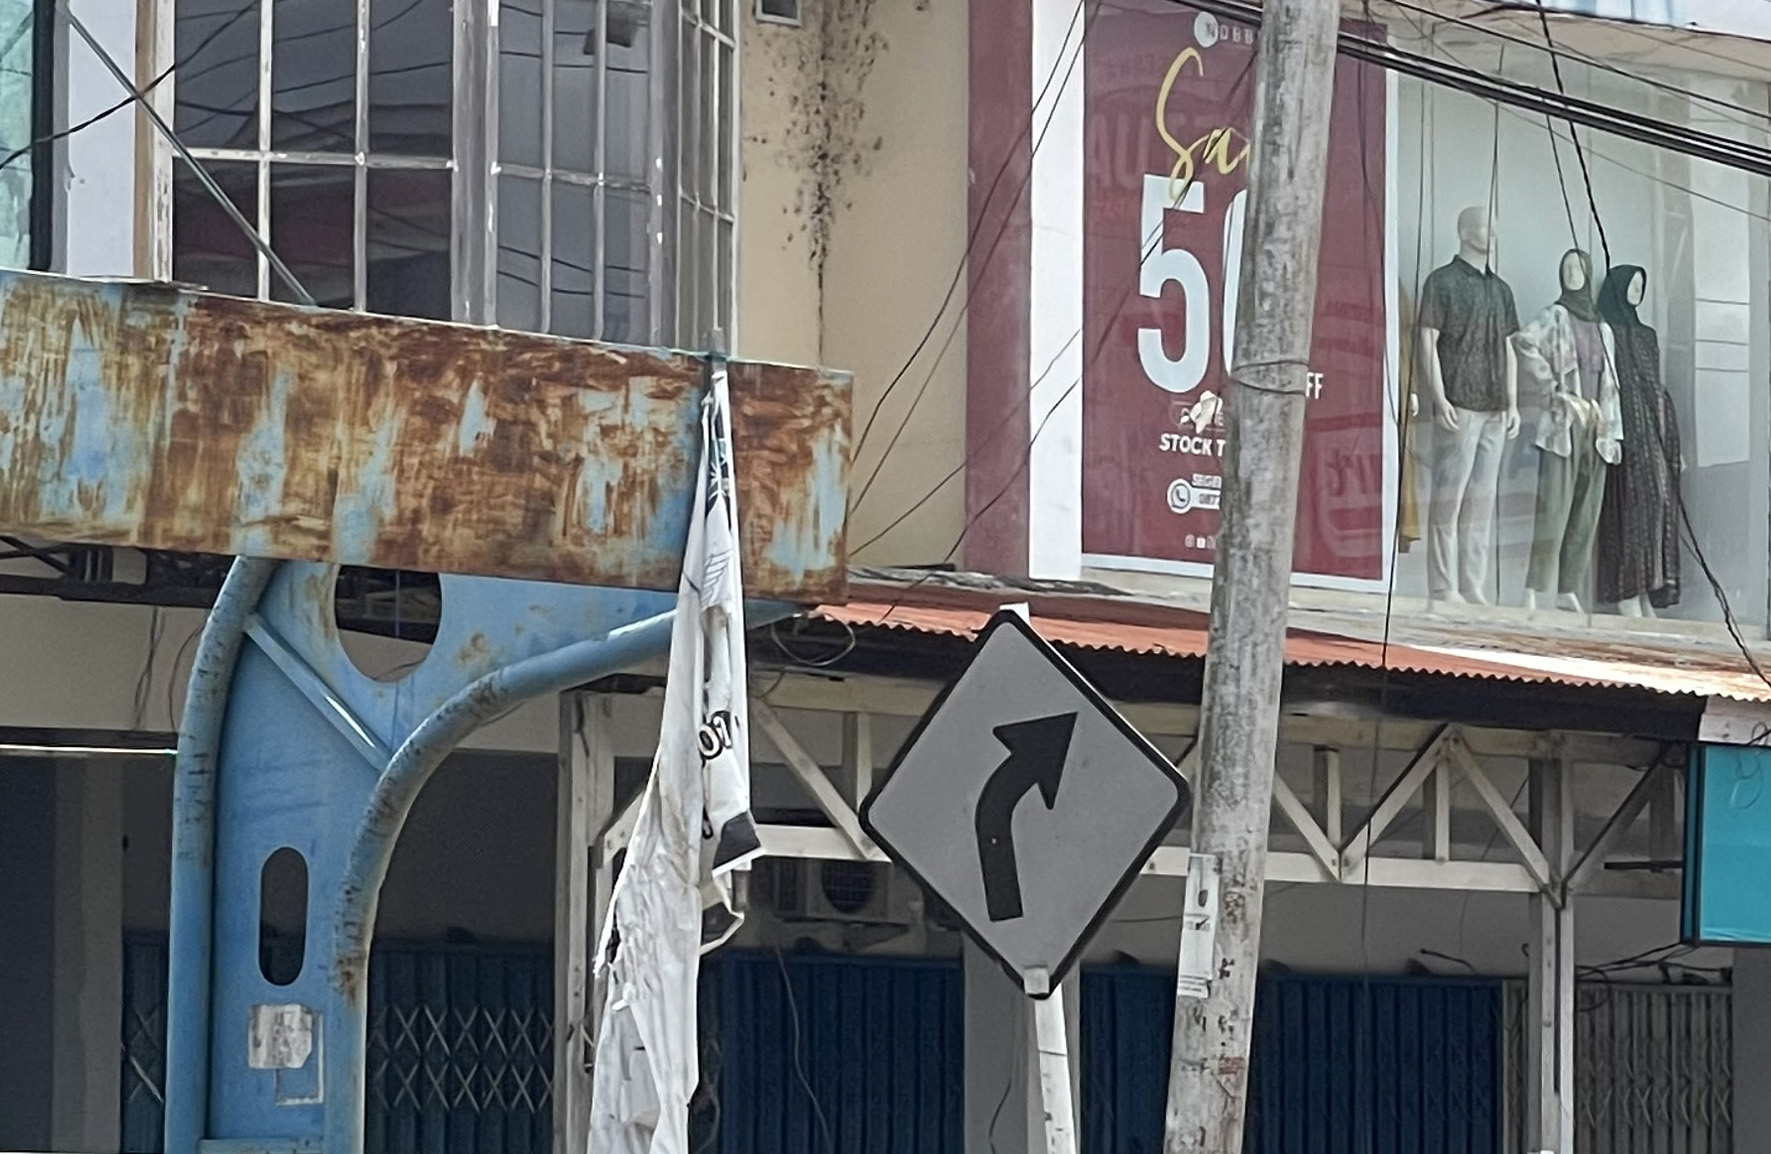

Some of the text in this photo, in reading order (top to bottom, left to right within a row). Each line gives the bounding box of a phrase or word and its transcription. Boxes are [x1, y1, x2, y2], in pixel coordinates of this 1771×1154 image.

[1138, 173, 1248, 393] 5
[1306, 372, 1324, 399] FF
[1159, 433, 1226, 457] STOCK T
